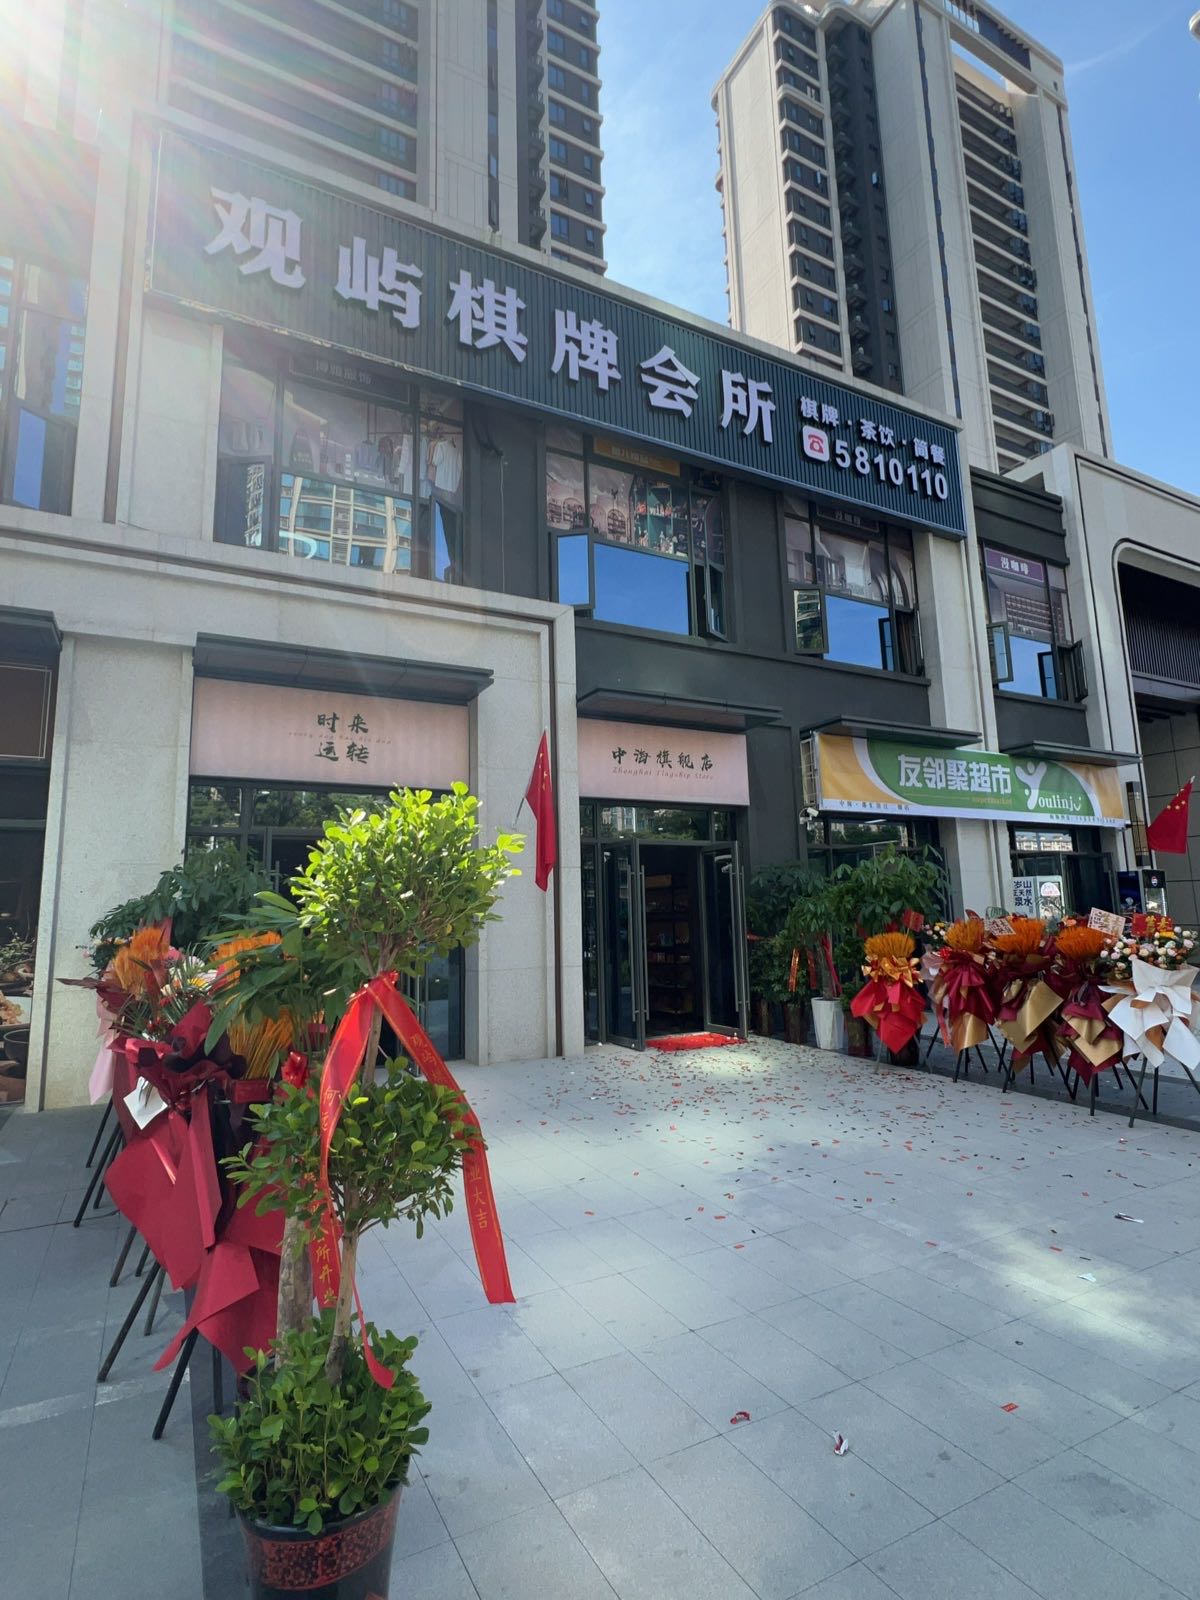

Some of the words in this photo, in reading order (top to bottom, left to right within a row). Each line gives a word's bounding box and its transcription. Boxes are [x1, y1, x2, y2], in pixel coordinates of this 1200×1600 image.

[204, 187, 776, 443] 观屿棋牌会所
[836, 439, 948, 500] 5810110
[317, 712, 369, 734] 时来
[315, 741, 370, 764] 运转
[612, 747, 713, 771] 中海旗舰店
[898, 754, 1012, 795] 友邻聚超市
